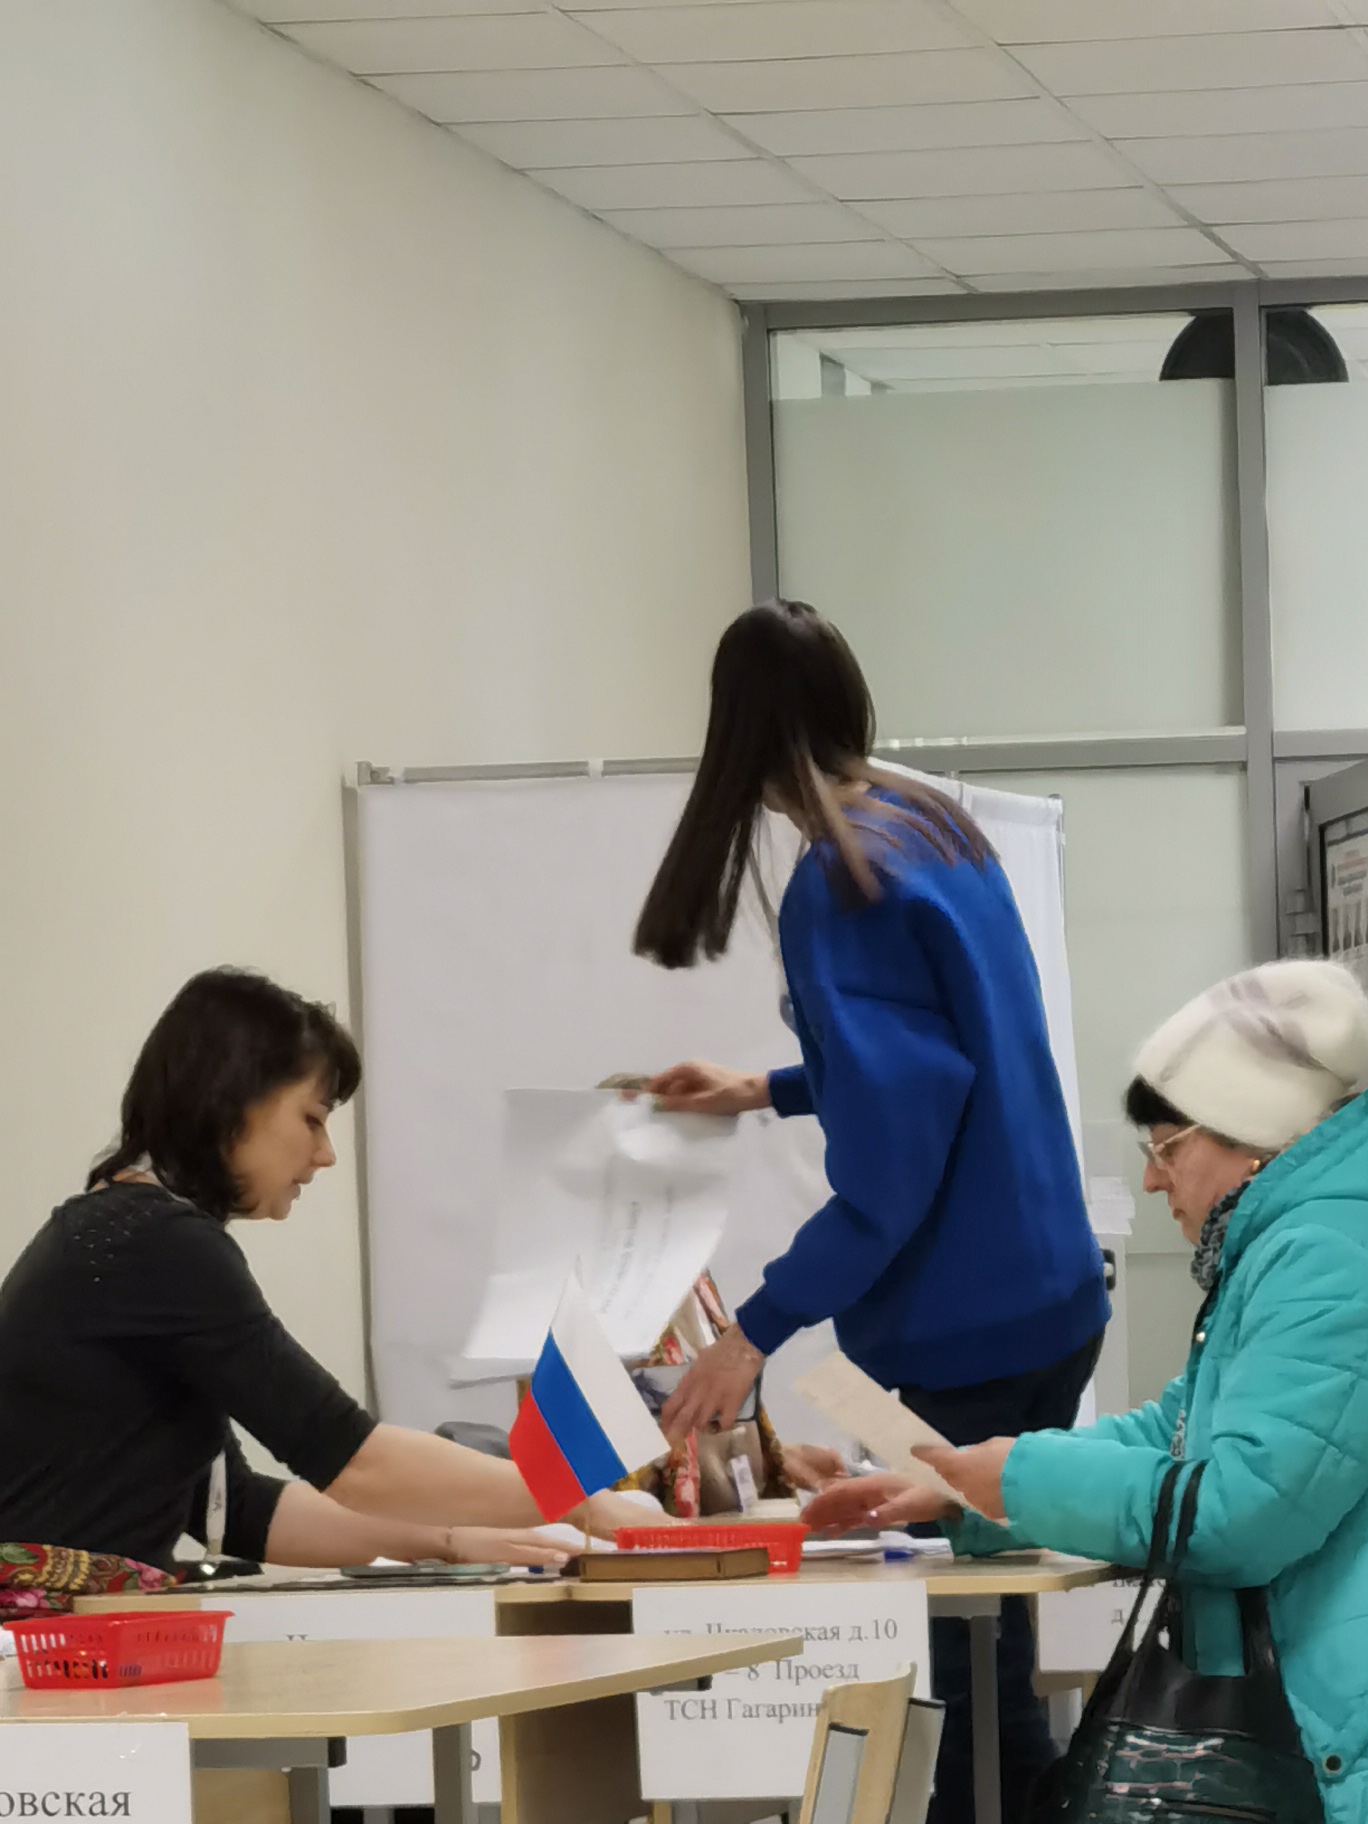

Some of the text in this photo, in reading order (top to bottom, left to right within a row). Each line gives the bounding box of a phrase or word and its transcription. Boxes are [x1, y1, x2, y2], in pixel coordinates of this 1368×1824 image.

[848, 1618, 898, 1643] д.10
[776, 1659, 860, 1686] Проезд
[663, 1699, 718, 1721] ТСН
